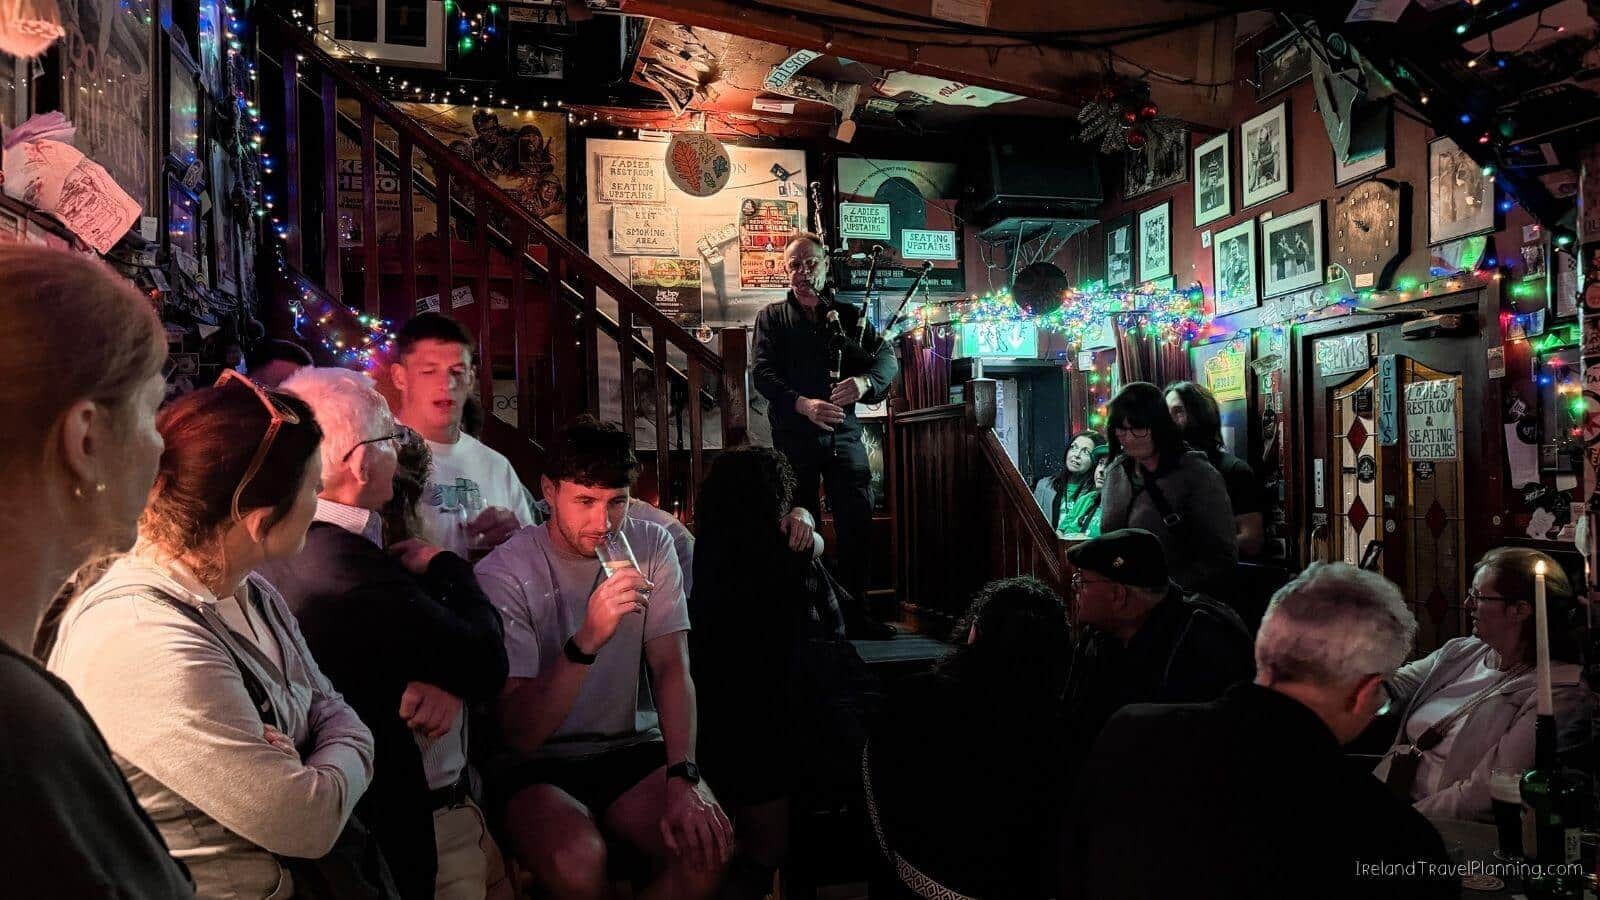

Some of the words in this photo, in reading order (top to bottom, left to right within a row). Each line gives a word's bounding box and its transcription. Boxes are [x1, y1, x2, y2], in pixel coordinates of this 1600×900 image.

[611, 160, 650, 168] LADIES
[610, 168, 654, 176] RESTROOM
[611, 182, 653, 191] SEATING
[609, 190, 652, 199] UPSTAIRS
[635, 211, 656, 219] EXIT
[850, 208, 880, 216] LADIES
[843, 215, 886, 224] RESTROOMS
[846, 223, 881, 232] UPSTAIRS
[626, 228, 665, 237] SMOKING
[635, 237, 658, 245] AREA
[909, 233, 948, 242] SEATING
[907, 241, 951, 251] UPSTAIRS
[1407, 384, 1448, 401] LADIES
[1382, 359, 1392, 443] GENTS
[1407, 399, 1455, 415] RESTROOM
[1425, 415, 1434, 427] &
[1409, 428, 1453, 443] SEATING
[1410, 443, 1456, 458] UPSTAIRS
